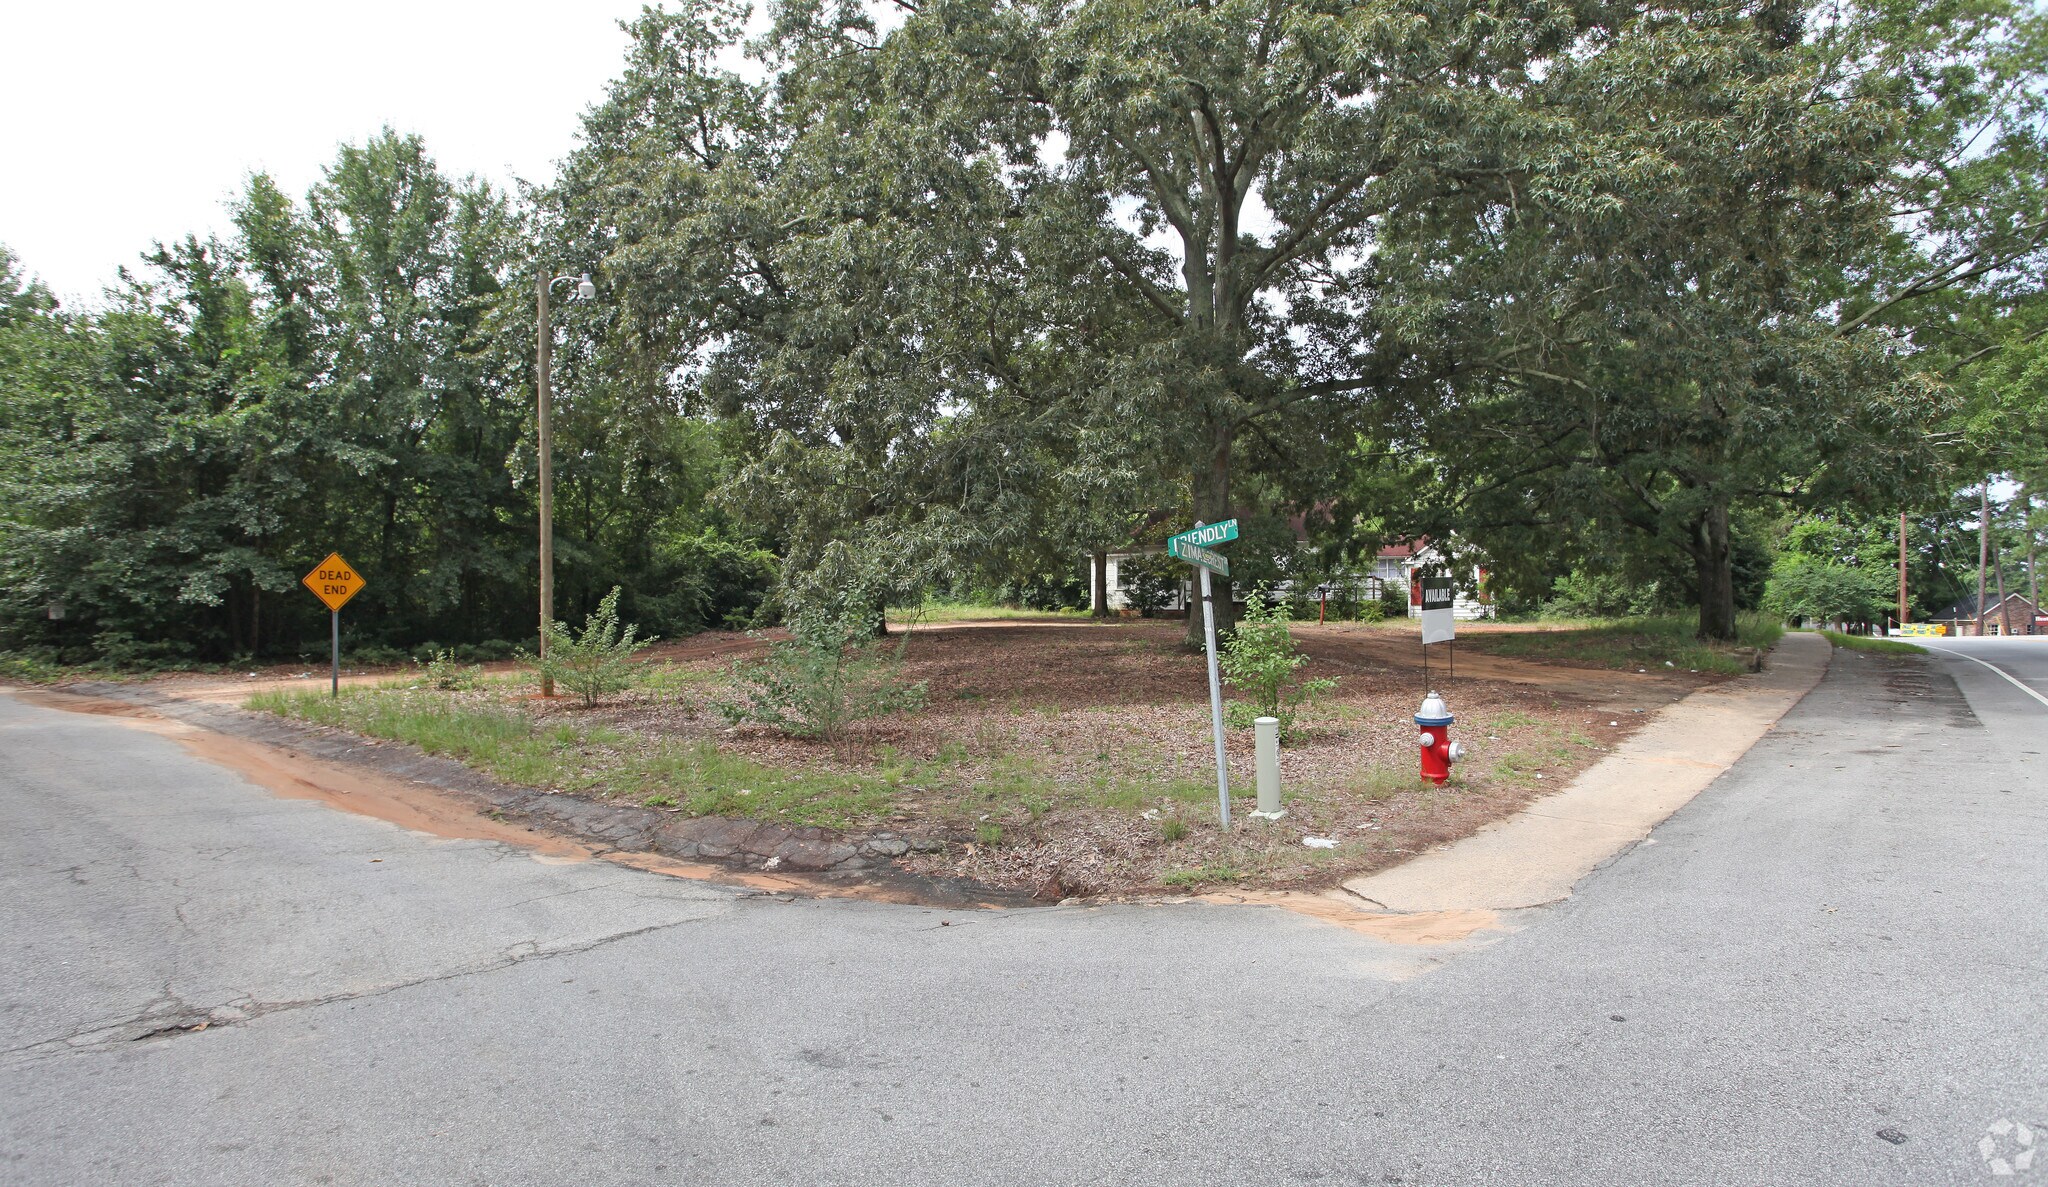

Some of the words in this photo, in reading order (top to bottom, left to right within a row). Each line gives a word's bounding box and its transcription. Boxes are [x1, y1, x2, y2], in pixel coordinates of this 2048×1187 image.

[1174, 523, 1228, 552] FRIENDLY
[1227, 518, 1237, 528] LN
[319, 570, 351, 581] DEAD
[324, 585, 347, 595] END
[1425, 588, 1451, 603] AVAILABLE
